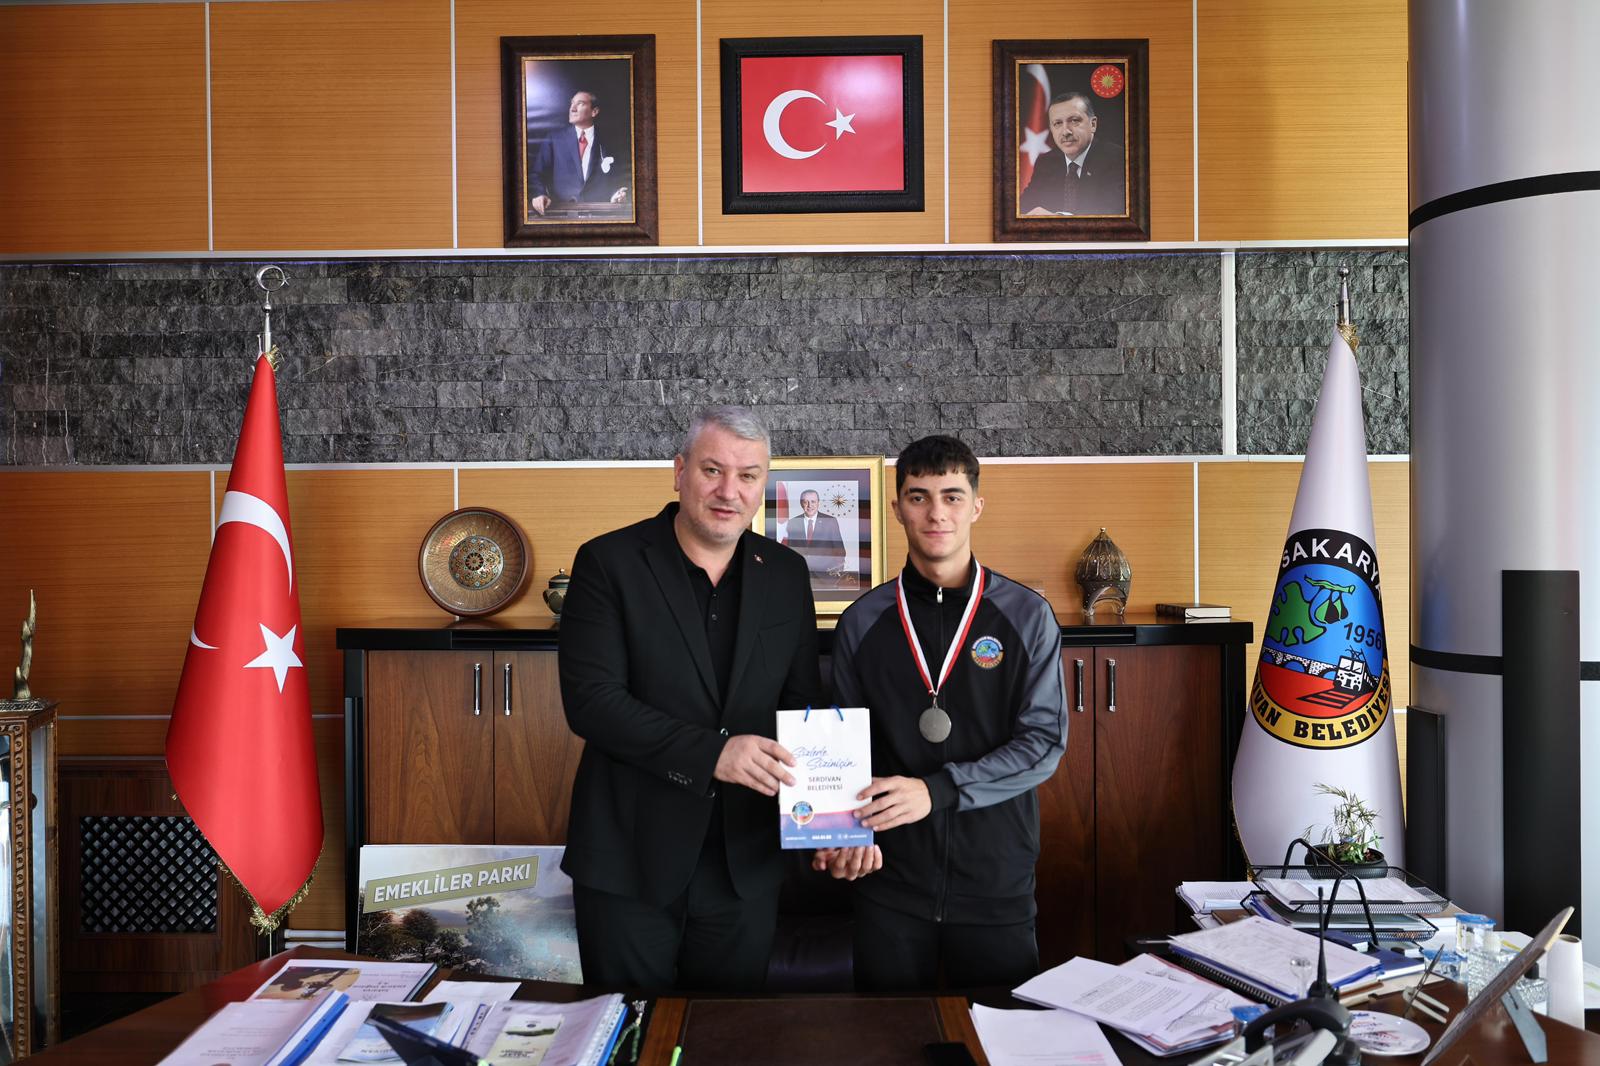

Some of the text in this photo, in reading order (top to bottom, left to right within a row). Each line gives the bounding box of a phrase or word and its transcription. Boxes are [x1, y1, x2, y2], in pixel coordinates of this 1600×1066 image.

[1343, 622, 1382, 651] 1956
[374, 863, 531, 903] EMEKLİLER PARKI
